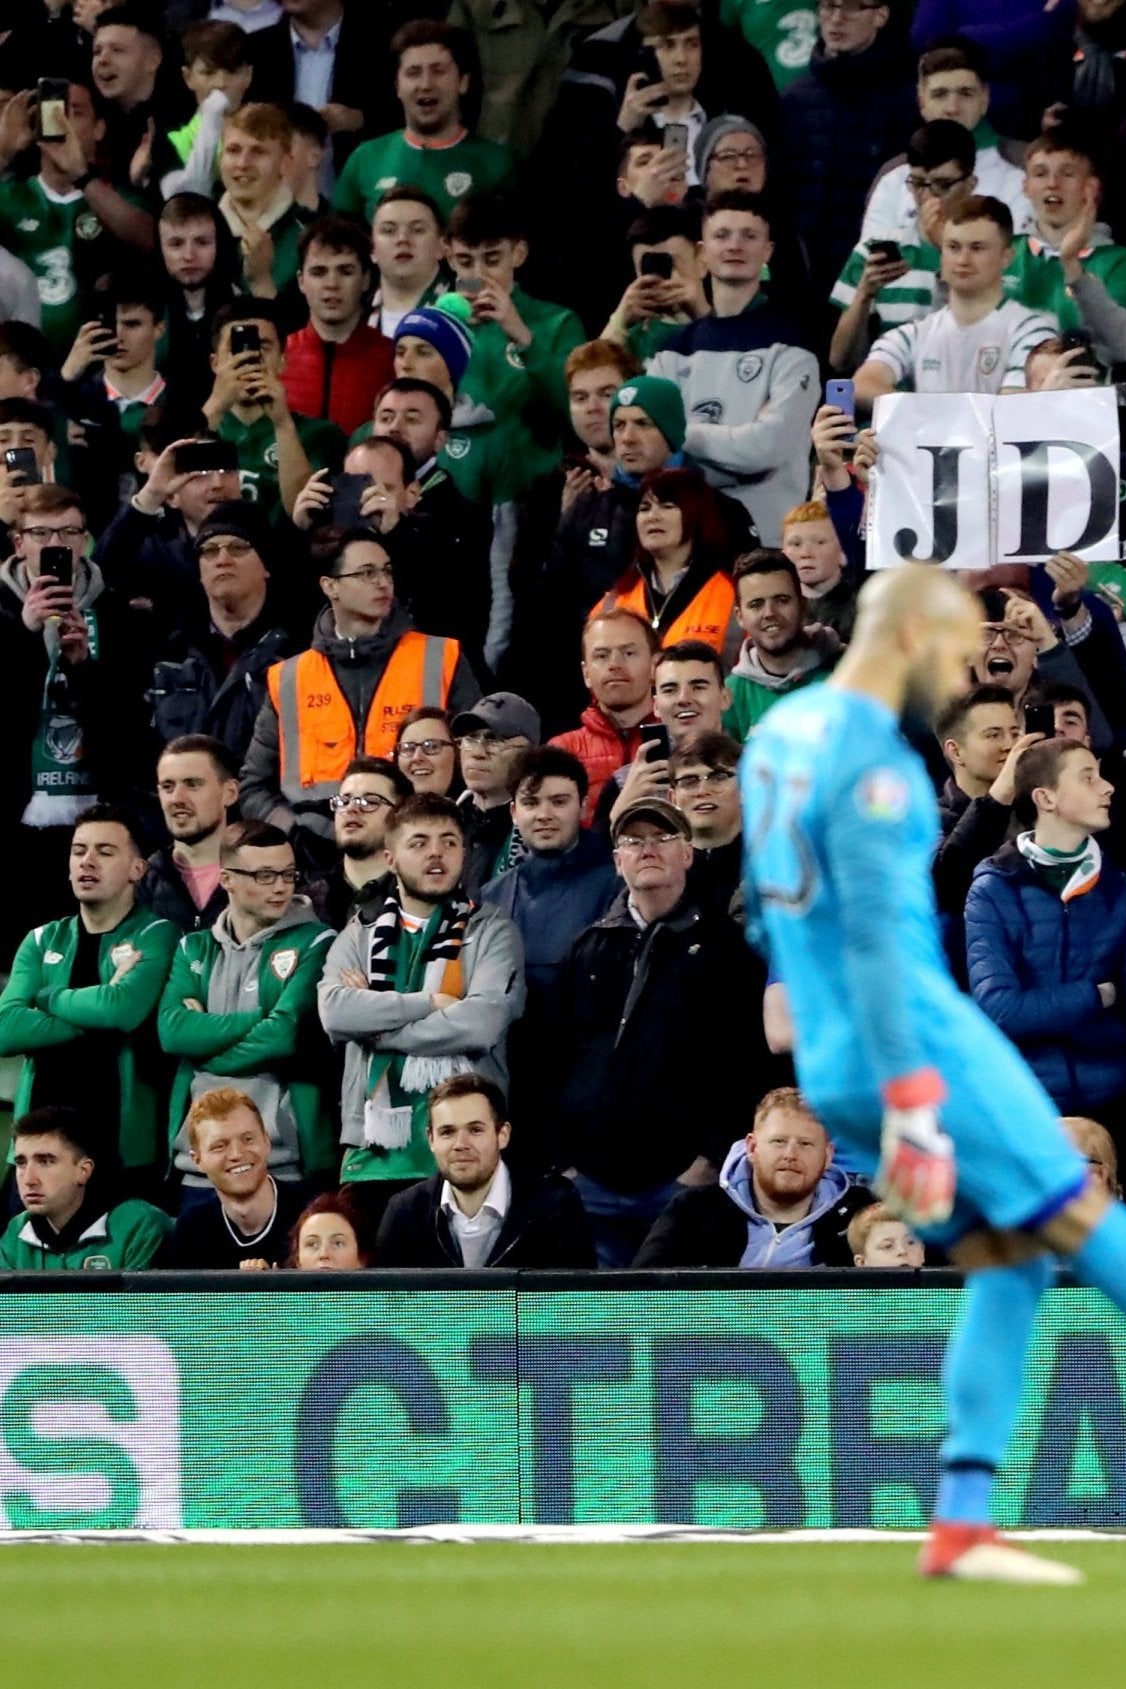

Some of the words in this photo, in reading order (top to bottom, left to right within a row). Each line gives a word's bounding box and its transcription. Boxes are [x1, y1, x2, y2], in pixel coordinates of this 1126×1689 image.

[775, 9, 818, 68] 3
[36, 246, 77, 305] 3
[893, 440, 1117, 562] JD
[306, 693, 332, 709] 239
[2, 1362, 141, 1529] S
